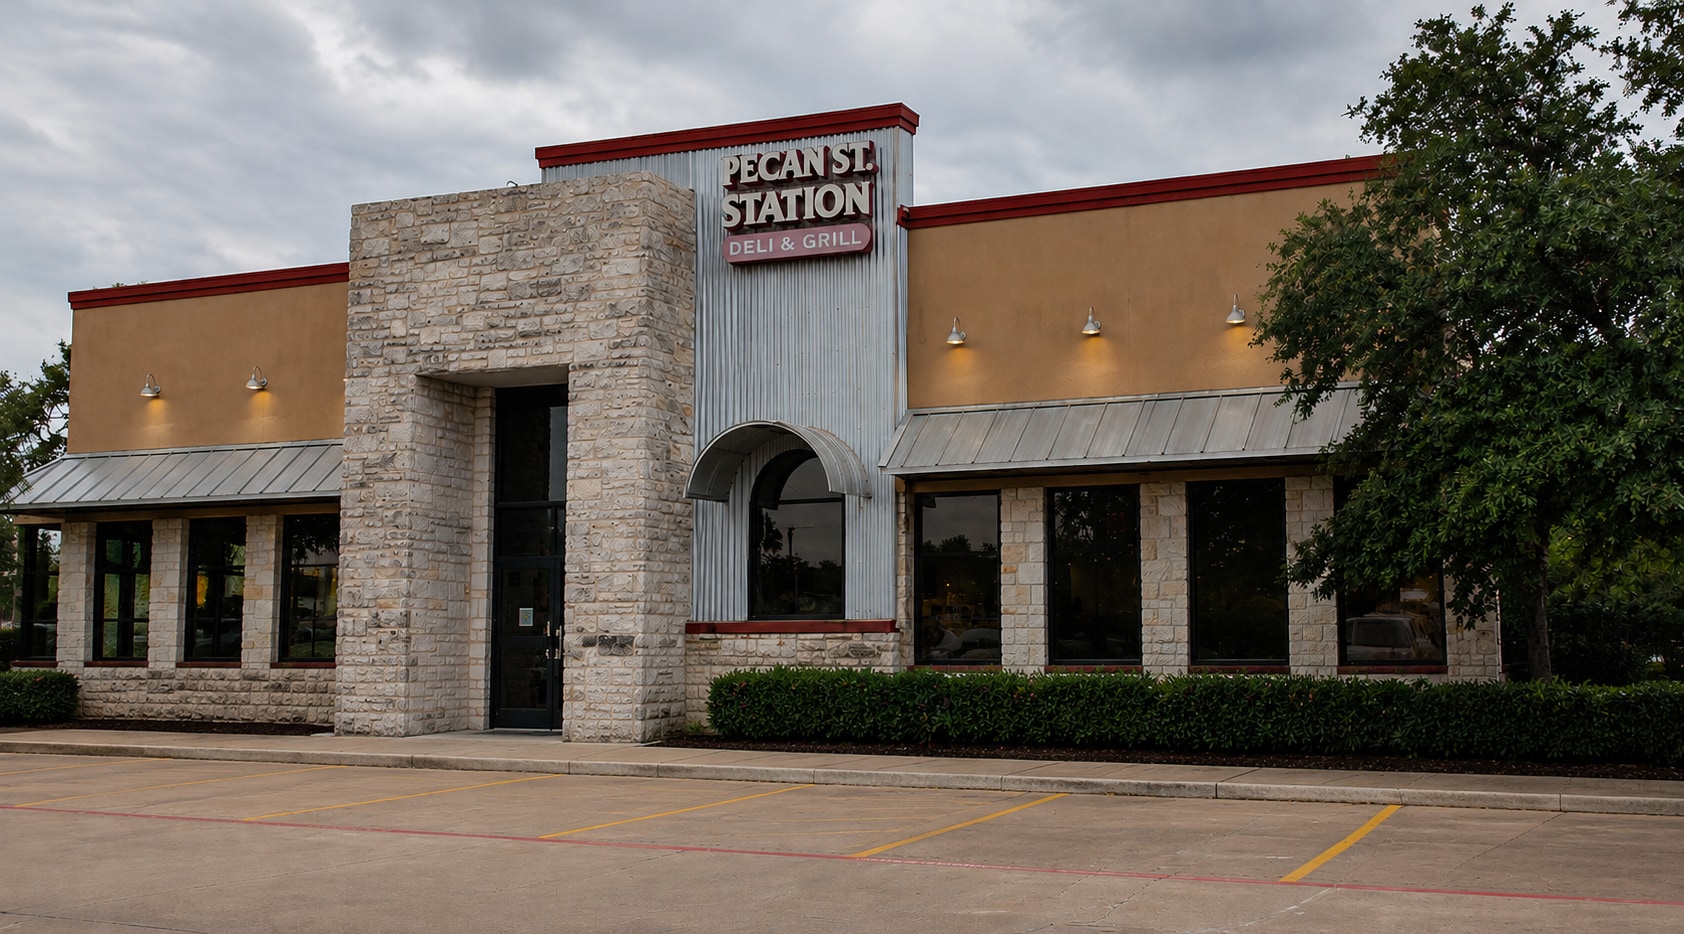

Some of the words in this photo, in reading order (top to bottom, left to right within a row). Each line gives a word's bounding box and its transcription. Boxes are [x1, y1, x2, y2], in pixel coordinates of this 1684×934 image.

[722, 145, 827, 186] PECAN
[831, 141, 874, 174] ST.
[722, 181, 870, 228] STATION
[729, 238, 773, 256] DELI
[781, 236, 795, 250] &
[803, 230, 862, 249] GRILL
